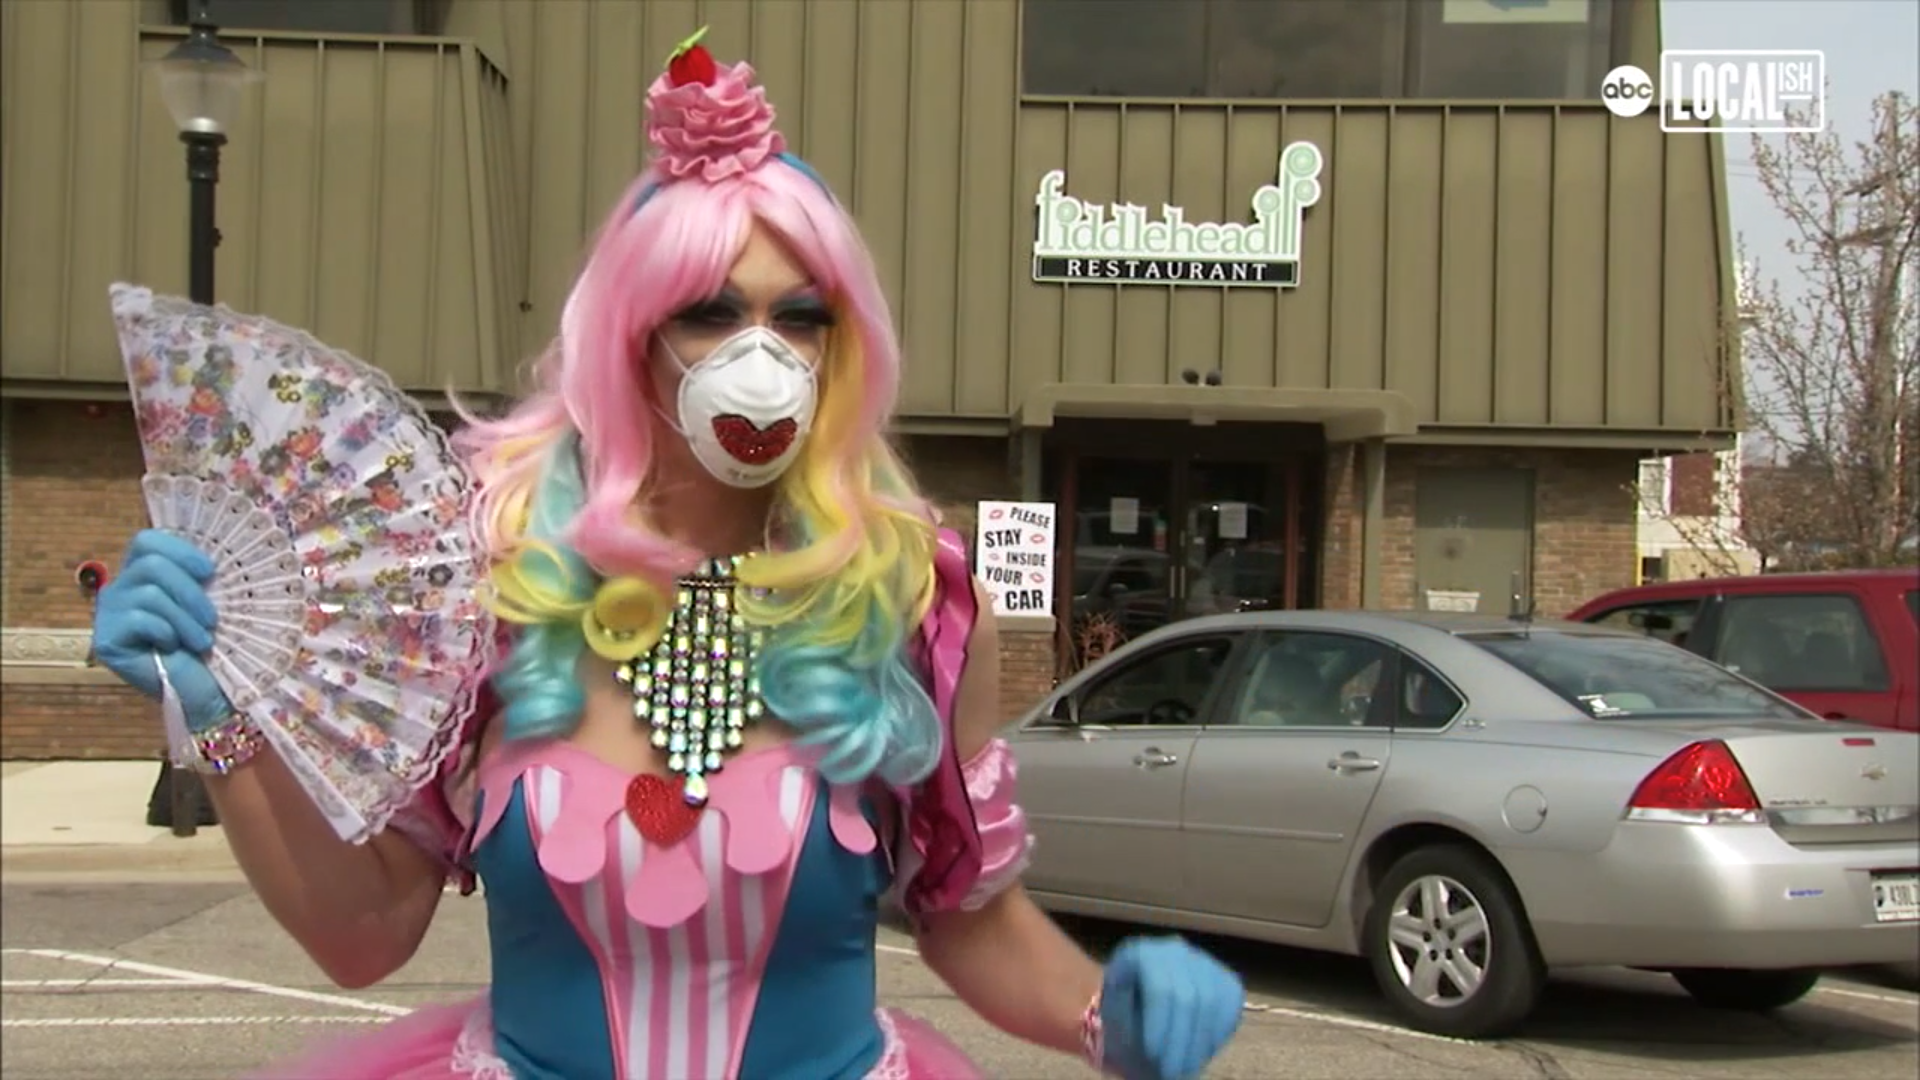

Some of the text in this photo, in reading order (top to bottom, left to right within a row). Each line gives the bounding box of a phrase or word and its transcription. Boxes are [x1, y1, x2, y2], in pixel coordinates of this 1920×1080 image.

[1037, 170, 1274, 254] fiddlehead
[1067, 259, 1268, 281] RESTAURANT
[1009, 506, 1051, 529] PLEASE
[984, 528, 1022, 548] STAY
[1006, 552, 1047, 567] INSIDE
[985, 566, 1023, 585] YOUR
[1005, 589, 1044, 611] CAR
